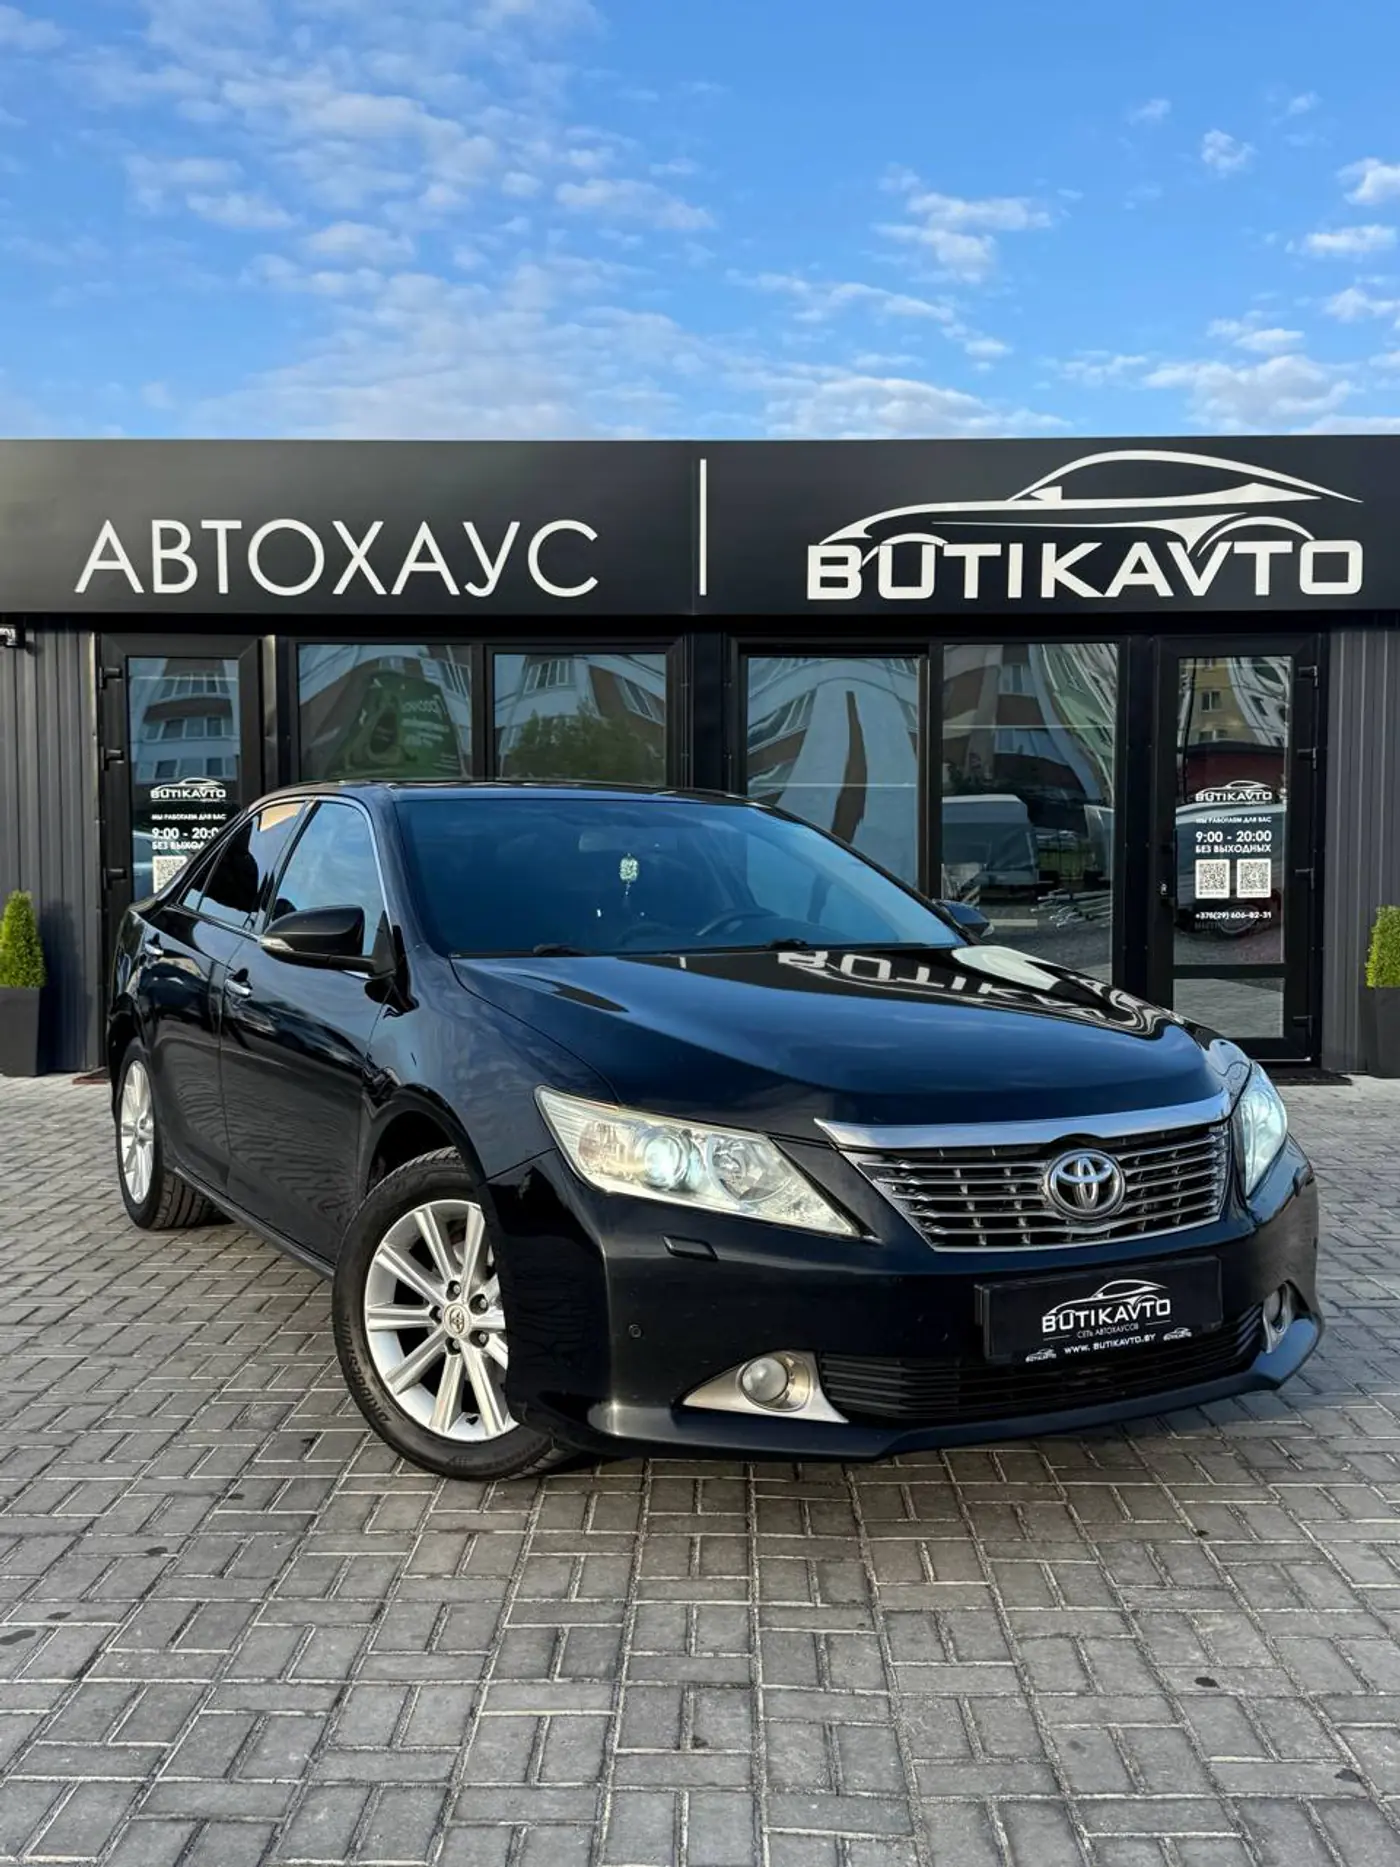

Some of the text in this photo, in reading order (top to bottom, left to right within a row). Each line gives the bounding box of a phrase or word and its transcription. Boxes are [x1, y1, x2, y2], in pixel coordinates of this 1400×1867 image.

[73, 518, 599, 598] АВТОХАУС
[806, 539, 1364, 602] BUTIKAVTO
[150, 789, 226, 799] BUTIKAVTO
[1195, 791, 1272, 802] BUTIKAVTO
[151, 827, 180, 839] 9:00
[1195, 831, 1223, 843] 9:00
[1236, 830, 1273, 843] 20:00
[152, 841, 168, 850] БЕЗ
[1195, 843, 1273, 854] БЕЗ ВЫХОДНЫХ
[1041, 1299, 1171, 1333] BUTIKAVTO
[1092, 1333, 1157, 1350] BUTIKAVTO.BY
